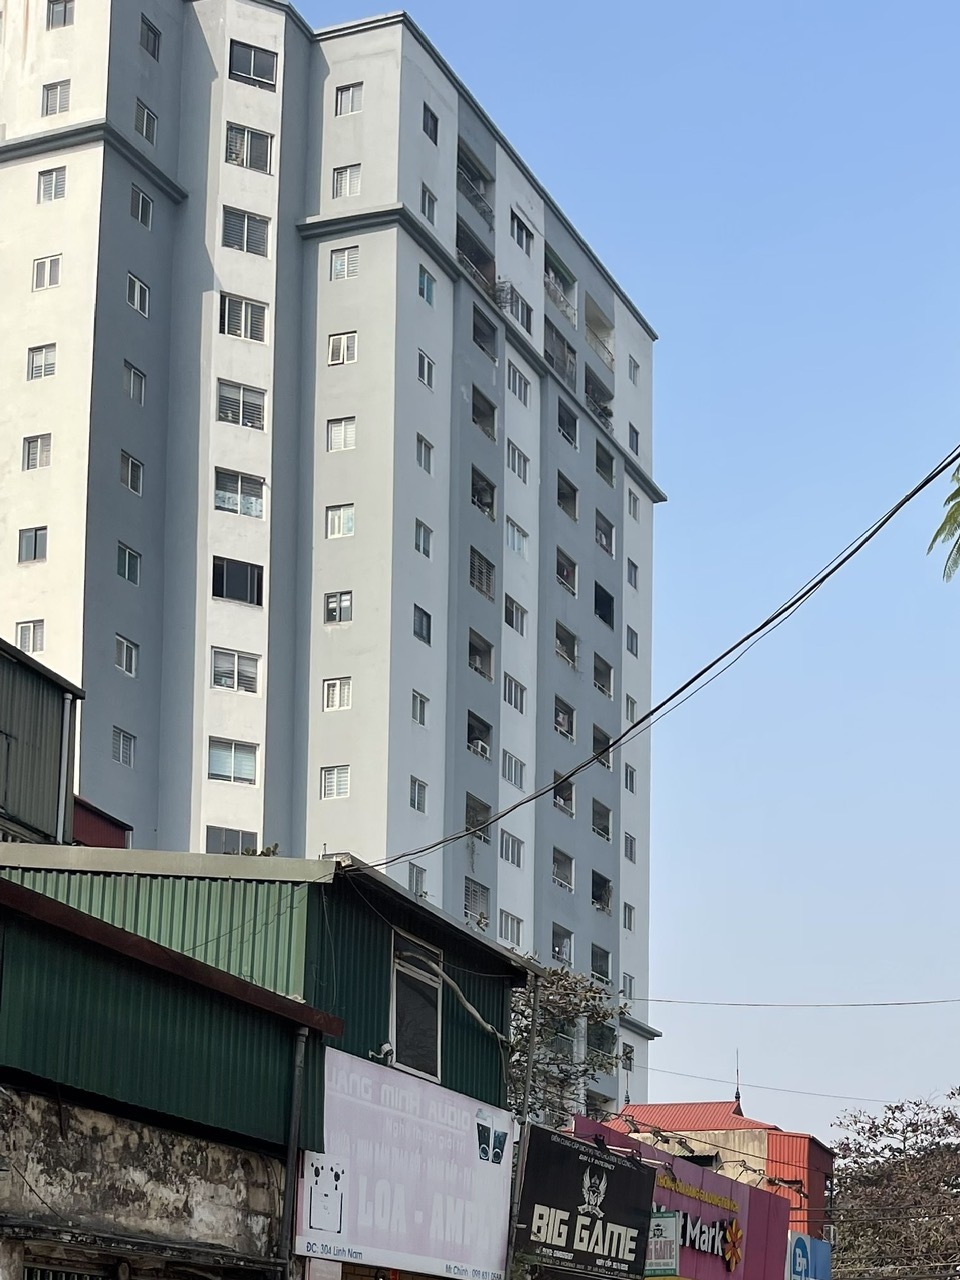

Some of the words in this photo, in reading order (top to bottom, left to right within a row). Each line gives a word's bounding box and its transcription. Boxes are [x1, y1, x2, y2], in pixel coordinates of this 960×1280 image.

[357, 1174, 407, 1233] LOA
[306, 1241, 319, 1254] ĐC:
[320, 1243, 332, 1254] 304
[347, 1248, 363, 1260] Nam
[530, 1203, 571, 1247] BIG
[572, 1214, 639, 1261] GAME
[685, 1216, 723, 1257] Mark
